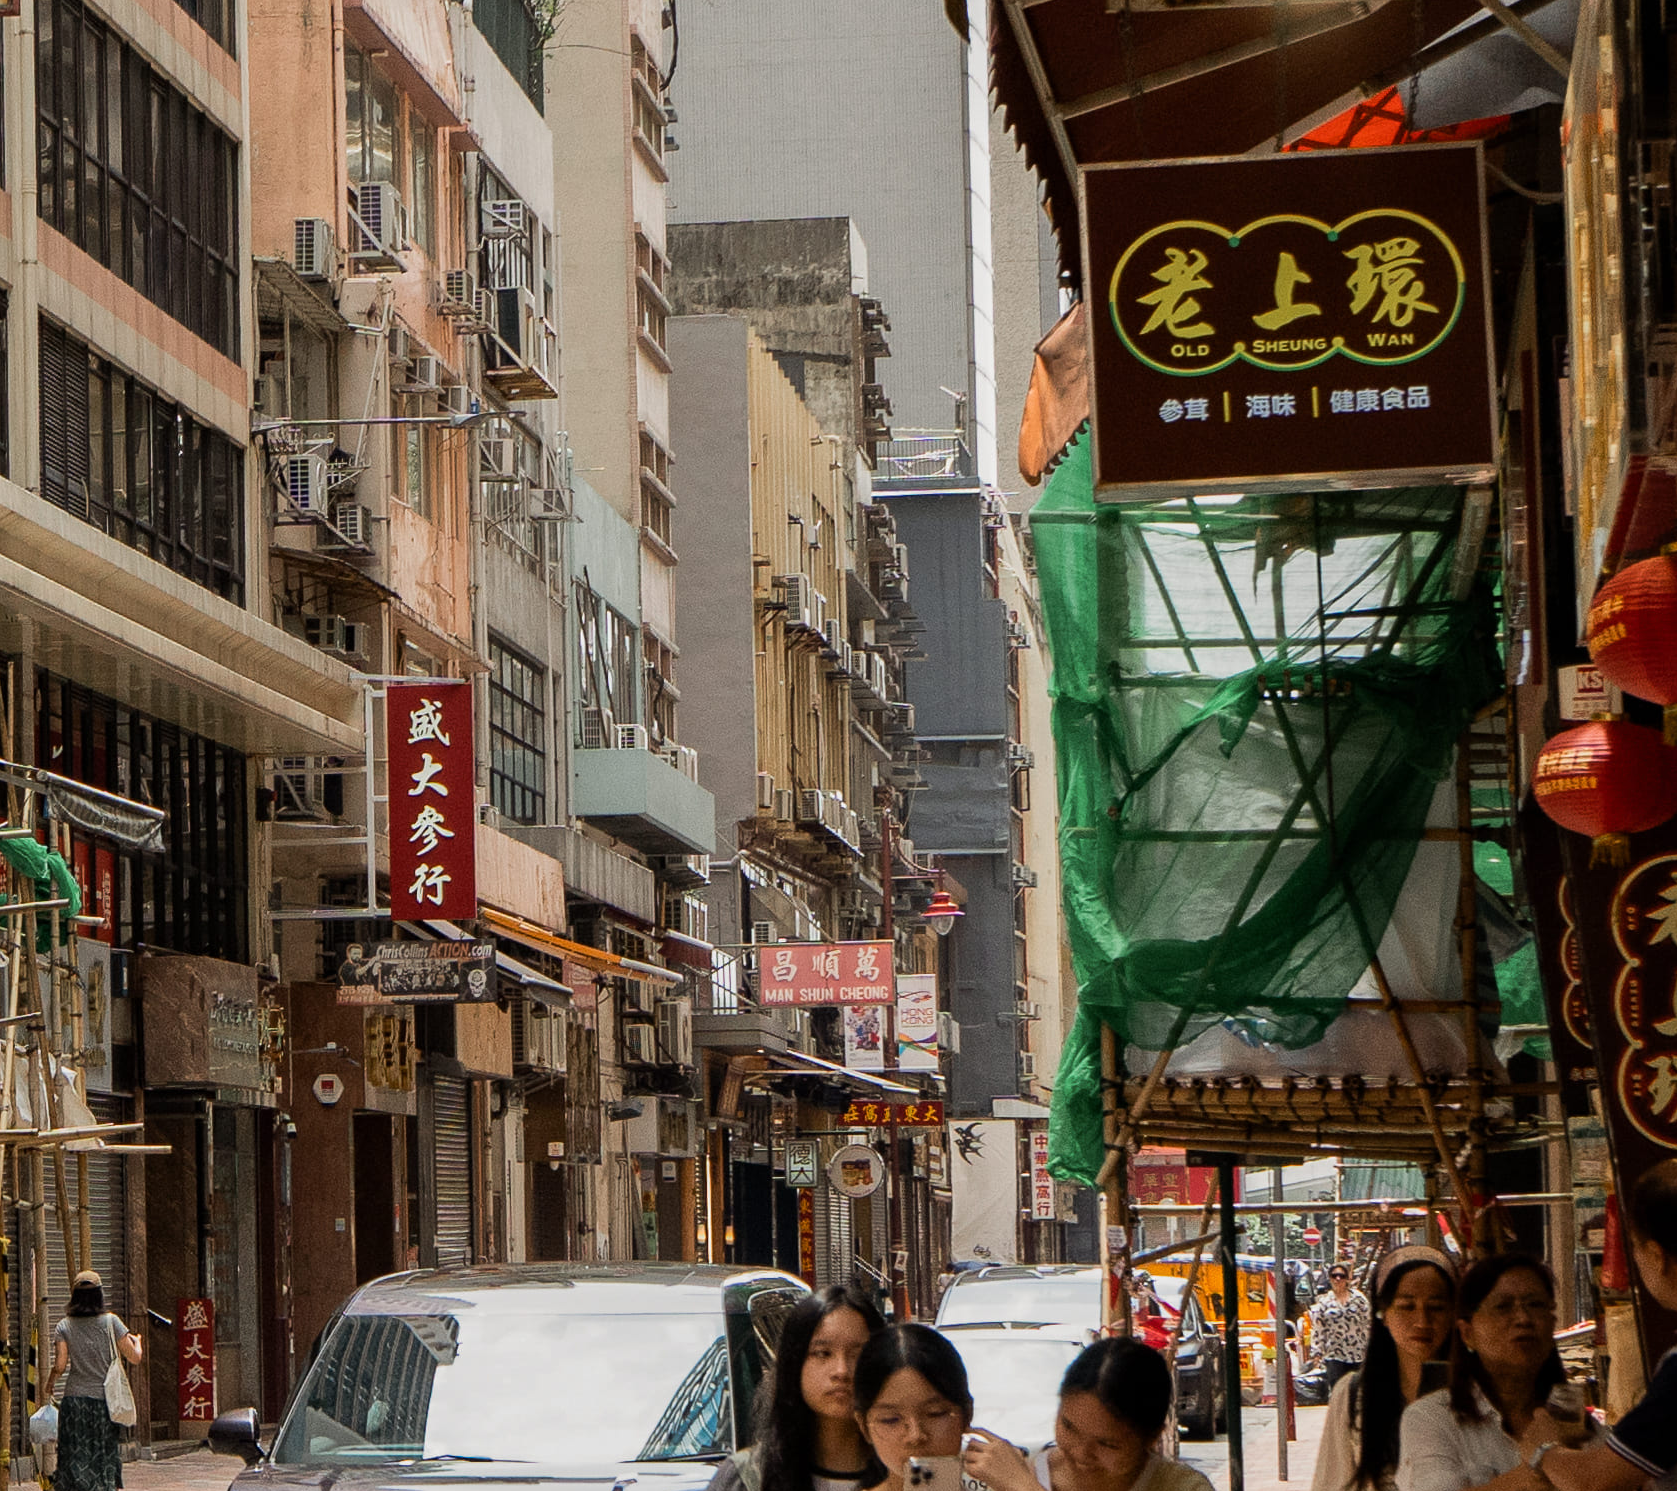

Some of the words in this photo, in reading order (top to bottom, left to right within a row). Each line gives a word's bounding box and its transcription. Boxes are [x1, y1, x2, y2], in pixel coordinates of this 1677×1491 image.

[1136, 237, 1439, 339] 老上環
[1159, 398, 1209, 422] 參茸
[1246, 394, 1296, 417] 海味
[1329, 386, 1431, 413] 健康食品
[407, 699, 455, 907] 盛大參行
[764, 988, 795, 1003] MAN
[798, 987, 834, 1002] SHUN
[839, 985, 889, 1001] CHEONG
[901, 1007, 933, 1016] HONG
[901, 1016, 933, 1025] KONG
[181, 1300, 213, 1419] 盛大參行
